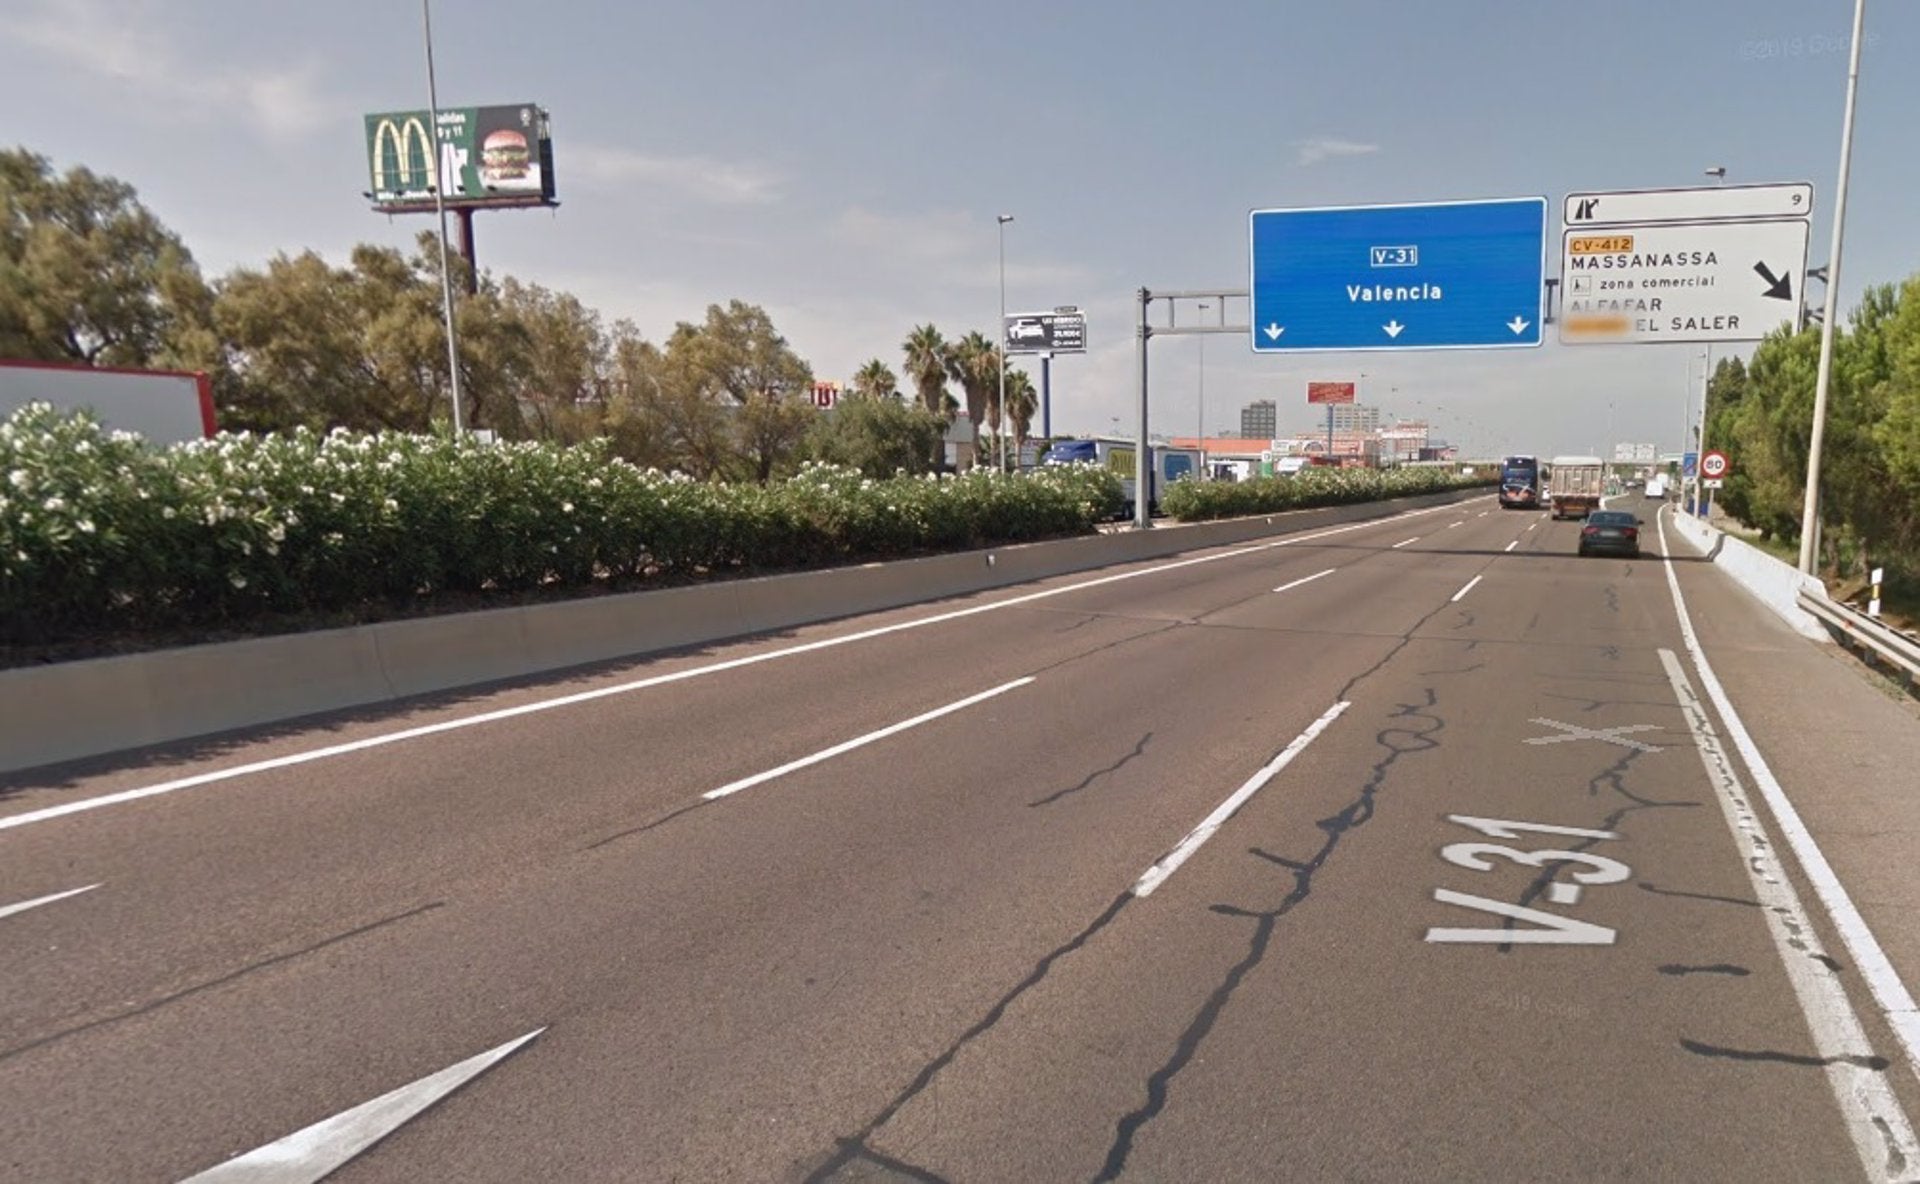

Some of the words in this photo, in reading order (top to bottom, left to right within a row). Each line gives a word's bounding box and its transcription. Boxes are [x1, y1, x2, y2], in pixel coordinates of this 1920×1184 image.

[1791, 194, 1802, 206] 9
[1572, 238, 1632, 252] CV-412
[1374, 249, 1416, 264] V-31
[1571, 252, 1718, 270] MASSANASSA
[1600, 278, 1634, 290] zona
[1642, 275, 1715, 289] comercial
[1346, 284, 1443, 302] Valencia
[1671, 316, 1740, 331] SALER
[1706, 460, 1722, 469] 80
[1424, 813, 1632, 945] V-31
